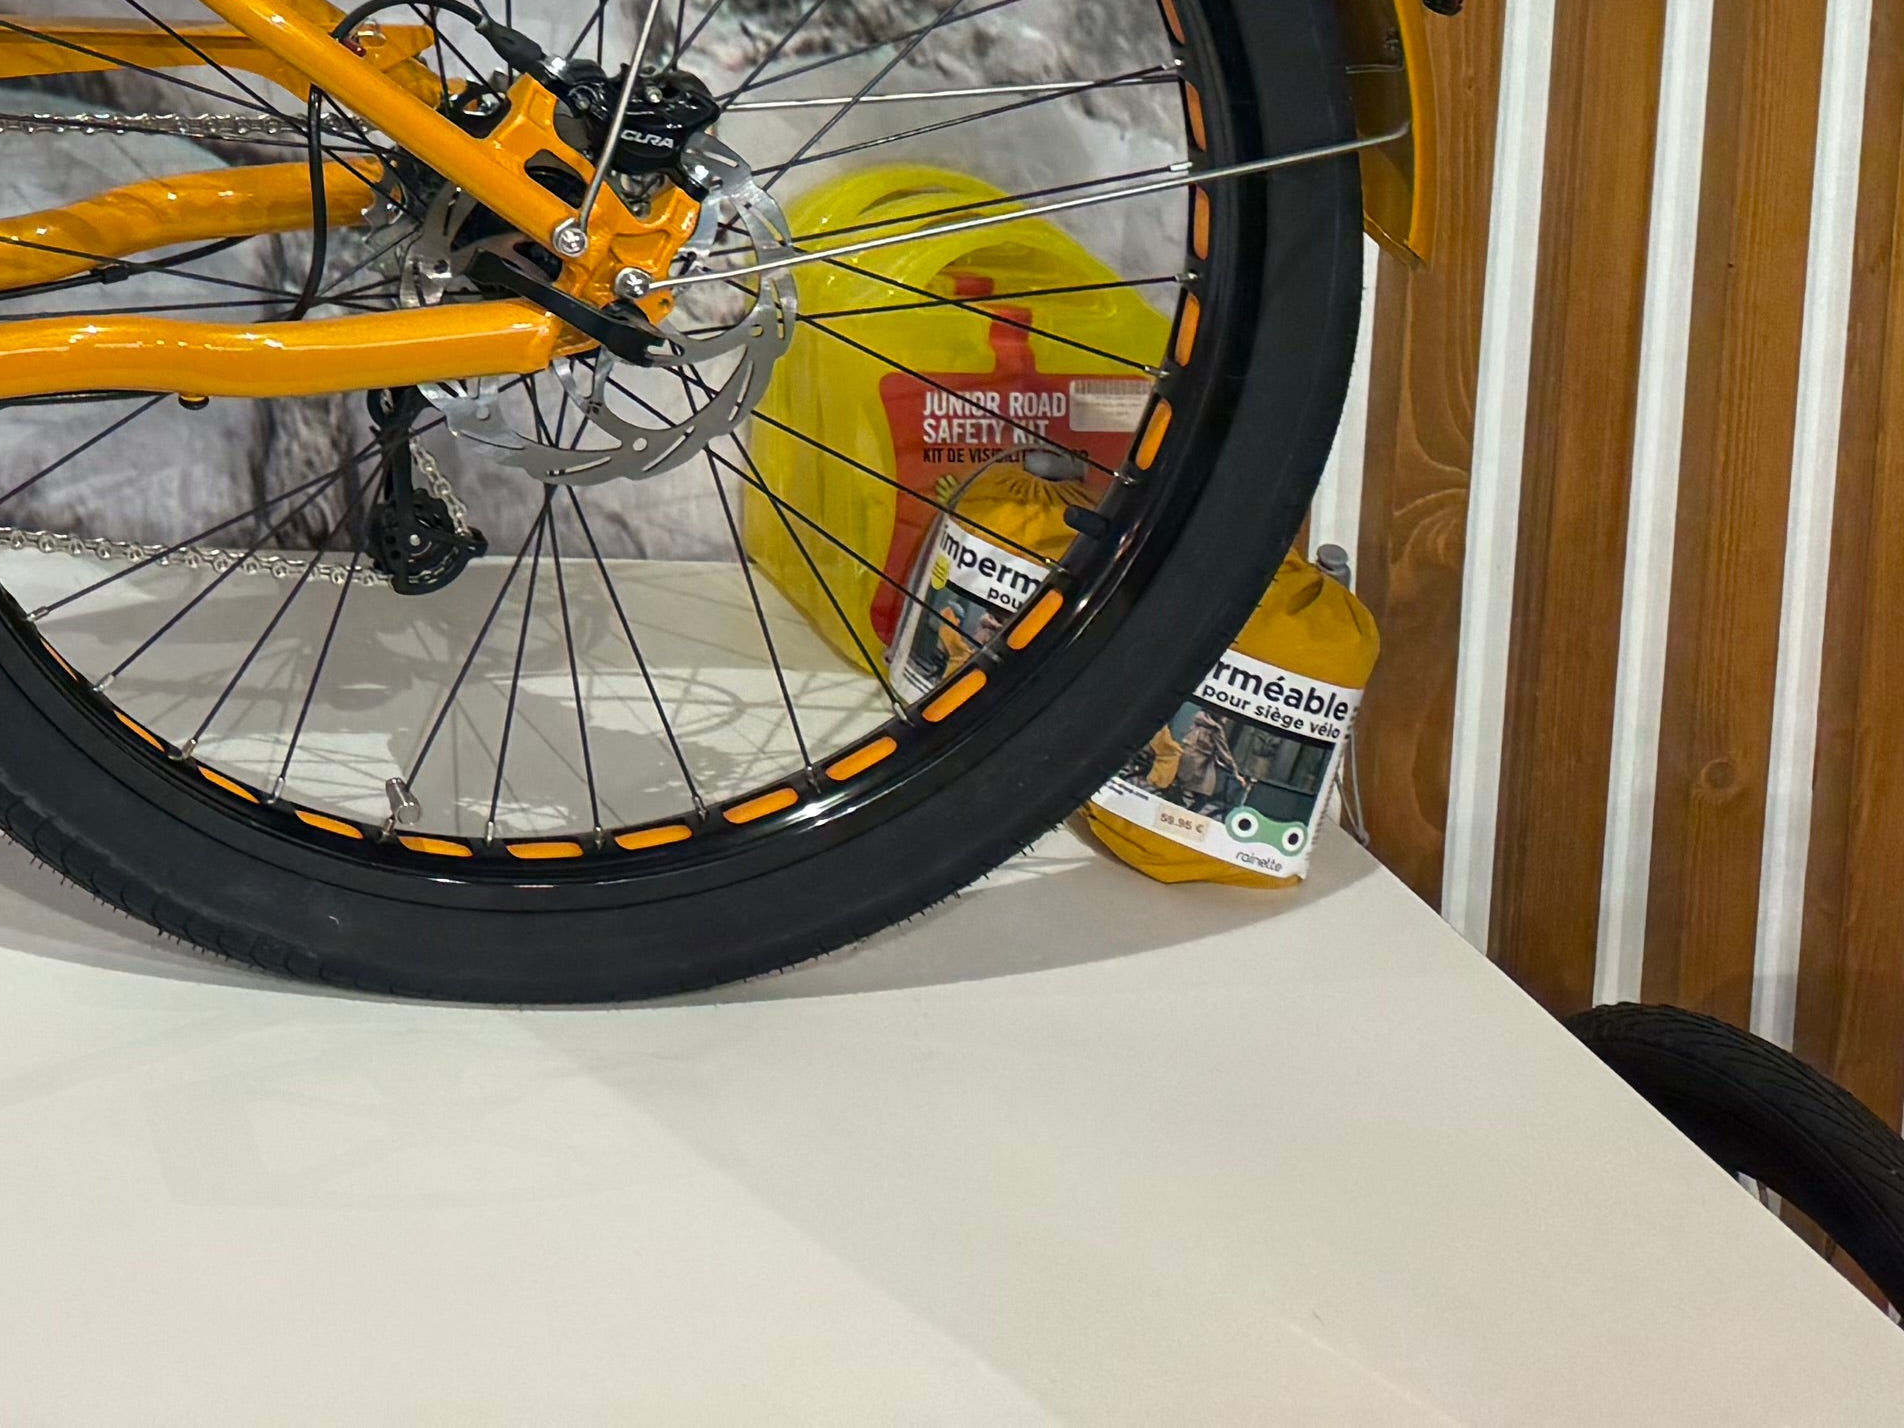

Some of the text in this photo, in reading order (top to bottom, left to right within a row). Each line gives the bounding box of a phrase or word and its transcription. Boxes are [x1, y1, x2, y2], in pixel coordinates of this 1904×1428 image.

[620, 129, 674, 149] CURA
[923, 391, 1000, 417] JUNIOR
[1008, 392, 1066, 417] ROAD
[923, 418, 1049, 445] SAFETY KIT
[923, 447, 944, 463] KIT
[947, 447, 965, 463] DE
[1212, 659, 1349, 722] rméable
[1202, 684, 1252, 711] pour
[1254, 704, 1305, 730] siège
[1309, 720, 1342, 740] vélo
[1235, 849, 1283, 874] rainette
